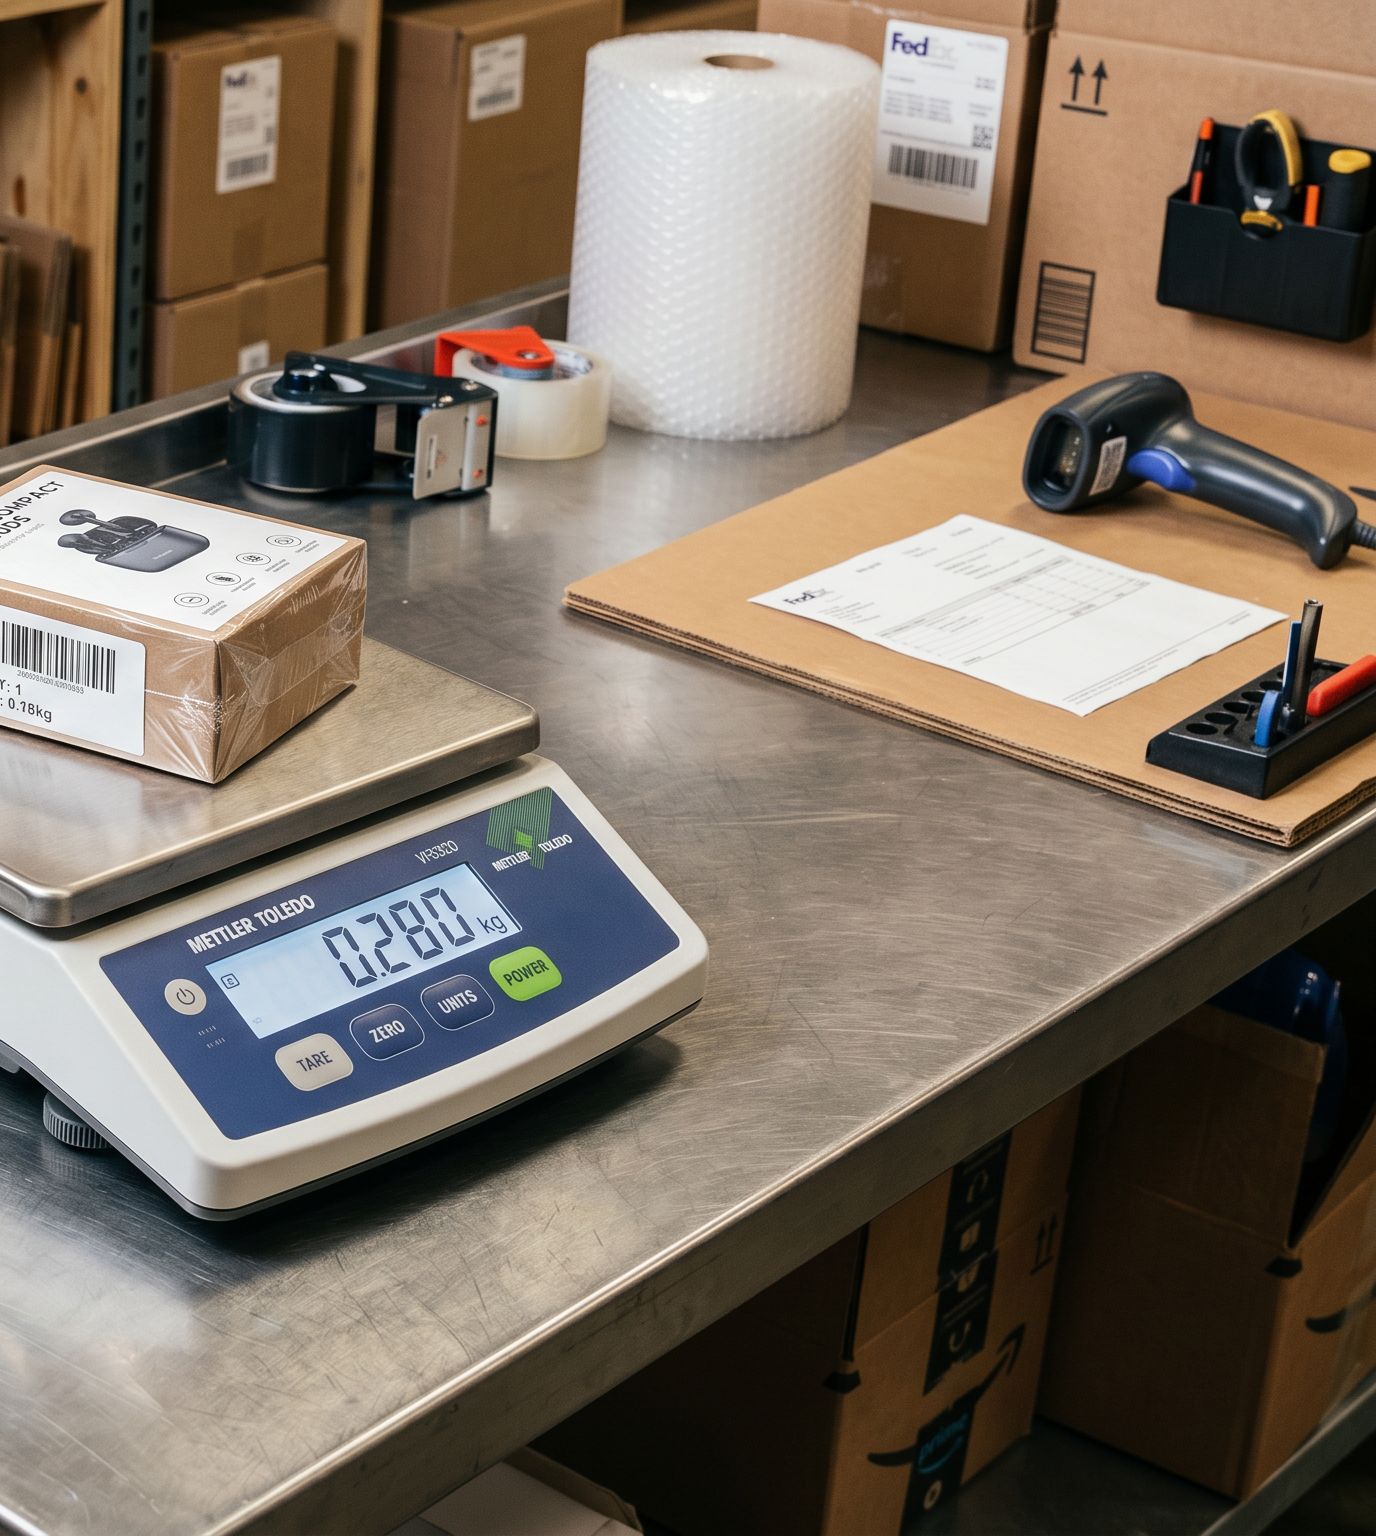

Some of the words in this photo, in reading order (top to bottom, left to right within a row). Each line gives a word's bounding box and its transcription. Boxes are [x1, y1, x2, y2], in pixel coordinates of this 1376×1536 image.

[15, 683, 21, 696] 1
[186, 918, 258, 954] METTLER
[254, 894, 316, 927] TOLEDO
[321, 887, 476, 988] 0.280
[477, 914, 509, 935] kg
[503, 959, 550, 986] POWER
[437, 989, 478, 1014] UNITS
[368, 1020, 405, 1043] ZERO
[296, 1050, 333, 1072] TARE
